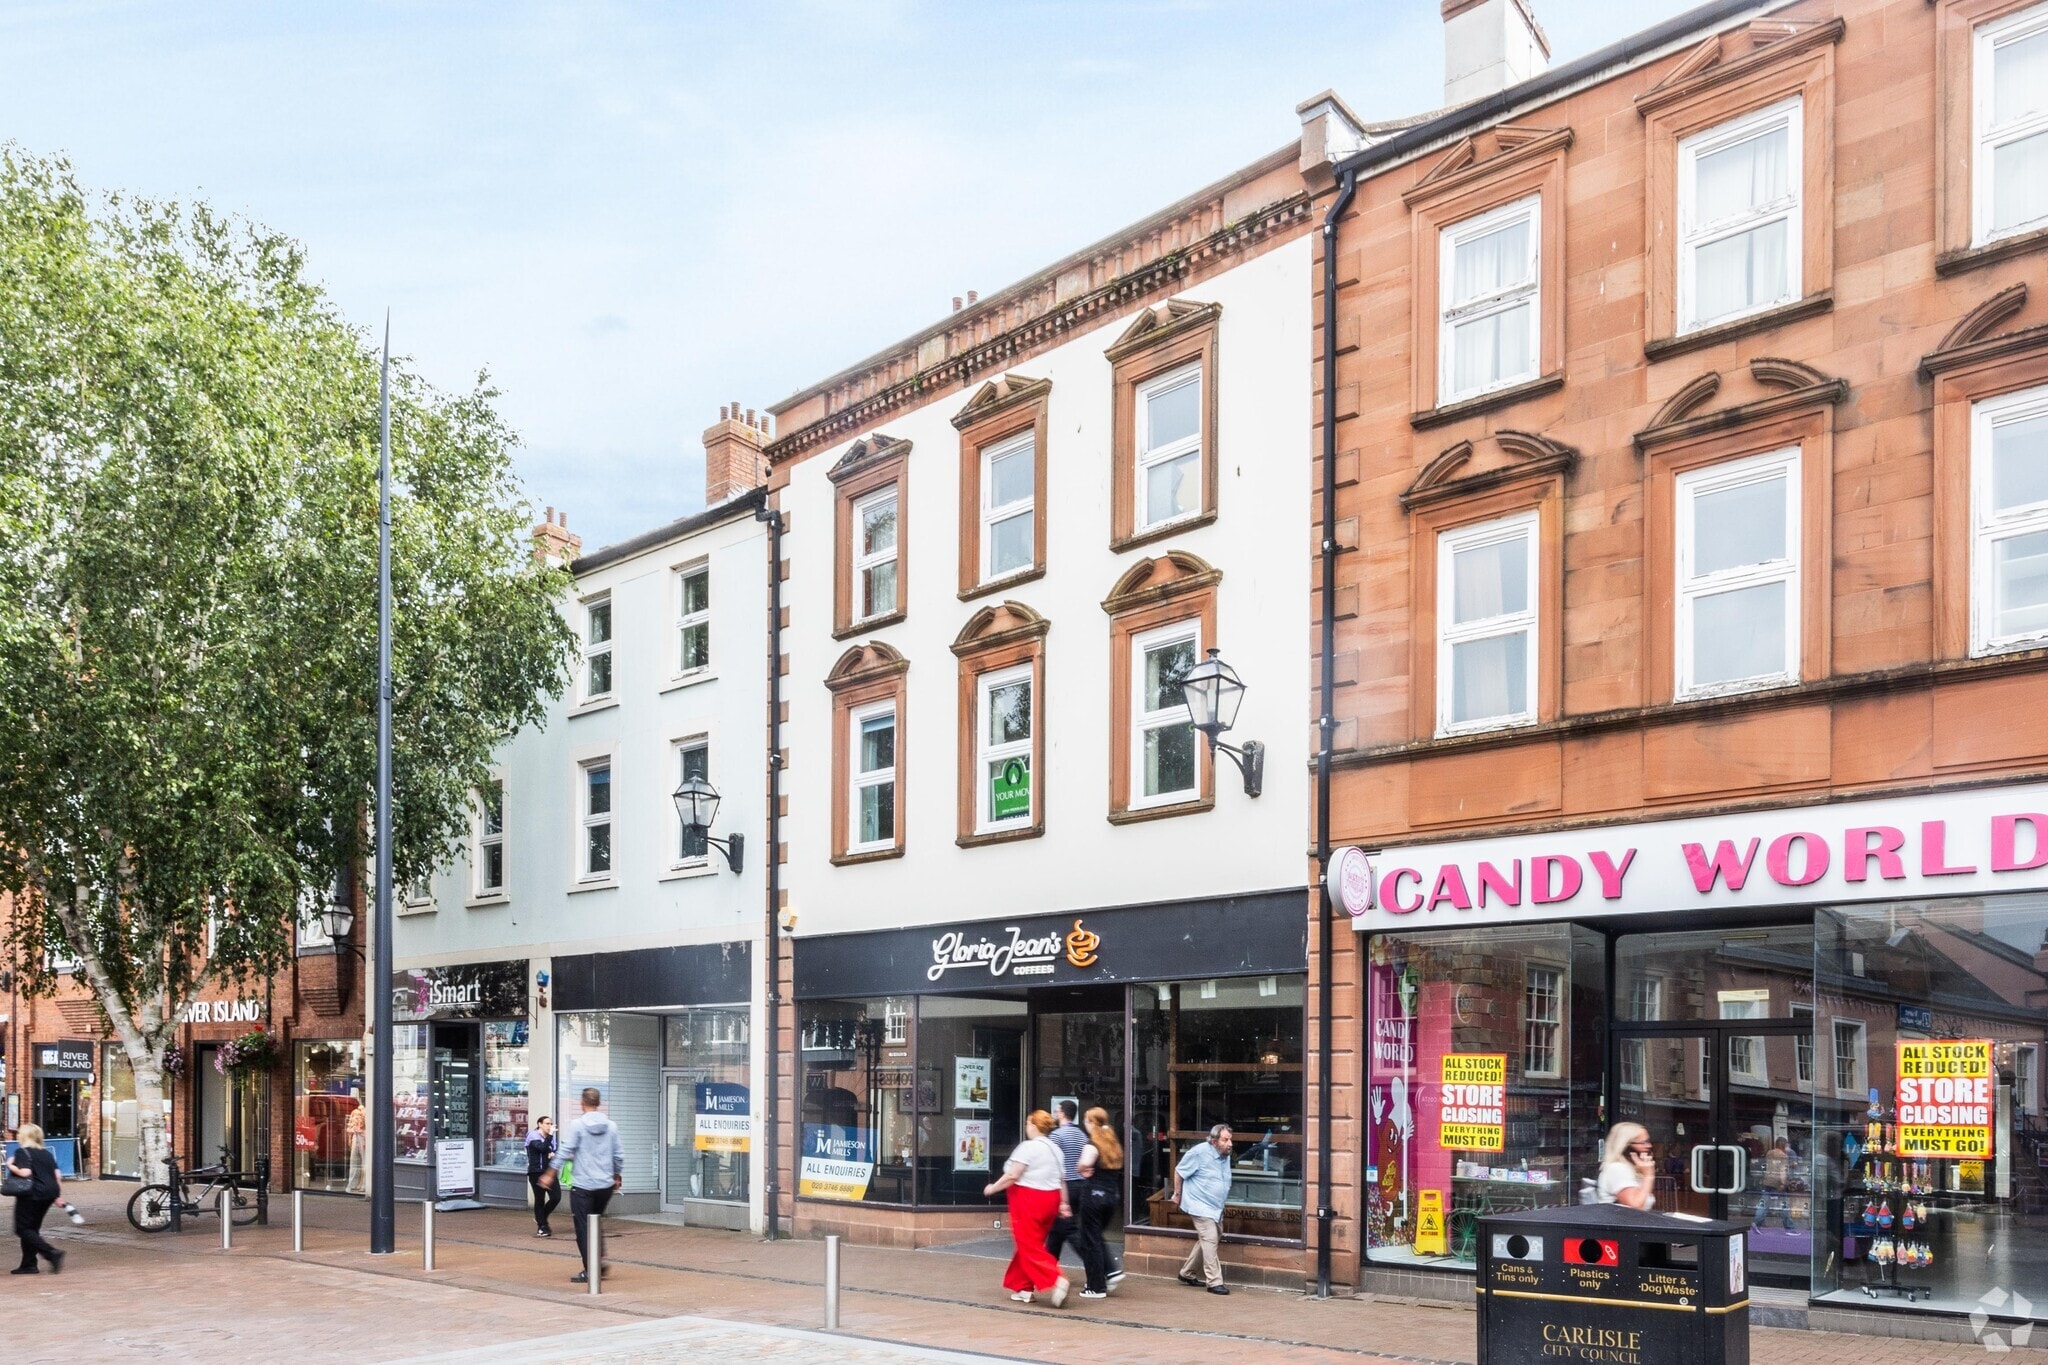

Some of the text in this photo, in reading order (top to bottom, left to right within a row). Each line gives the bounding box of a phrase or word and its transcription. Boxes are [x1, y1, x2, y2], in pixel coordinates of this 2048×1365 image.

[996, 790, 1014, 801] YOUR
[1379, 813, 2048, 915] CANDY WORLD
[927, 927, 1062, 981] Gloria Jean's
[429, 980, 480, 1004] iSmart
[213, 1000, 259, 1022] ISLAND
[1376, 1018, 1411, 1041] CANDY
[63, 1052, 88, 1060] RIVER
[1374, 1041, 1413, 1062] WORLD
[1904, 1046, 1985, 1058] ALL STOCK
[60, 1060, 91, 1069] ISLAND
[1445, 1058, 1501, 1069] ALL STOCK
[1904, 1061, 1986, 1074] REDUCED!
[1445, 1070, 1502, 1082] REDUCED!
[1442, 1084, 1503, 1107] STORE
[1900, 1078, 1989, 1104] STORE
[1441, 1107, 1502, 1124] CLOSING
[1900, 1105, 1988, 1125] CLOSING
[700, 1120, 750, 1130] ALL ENQUIRIES
[1444, 1126, 1500, 1135] EVERYTHING
[1904, 1128, 1985, 1138] EVERYTHING
[833, 1139, 866, 1149] JAMIESON
[1444, 1135, 1499, 1147] MUST GO!
[1904, 1139, 1984, 1152] MUST GO!
[832, 1148, 851, 1156] MILLS
[806, 1163, 866, 1178] ALL ENQUIRIES
[1223, 1208, 1260, 1219] NDMADE
[1262, 1211, 1286, 1220] SINCE
[1501, 1263, 1533, 1274] Cans &
[1570, 1268, 1610, 1280] Plastics
[1496, 1272, 1539, 1286] Tins only
[1579, 1279, 1601, 1291] only
[1649, 1274, 1687, 1285] Litter &
[1640, 1283, 1696, 1296] Dog Waste
[1543, 1324, 1641, 1350] CARLISLE
[1543, 1343, 1641, 1365] CITY COUNCIL
